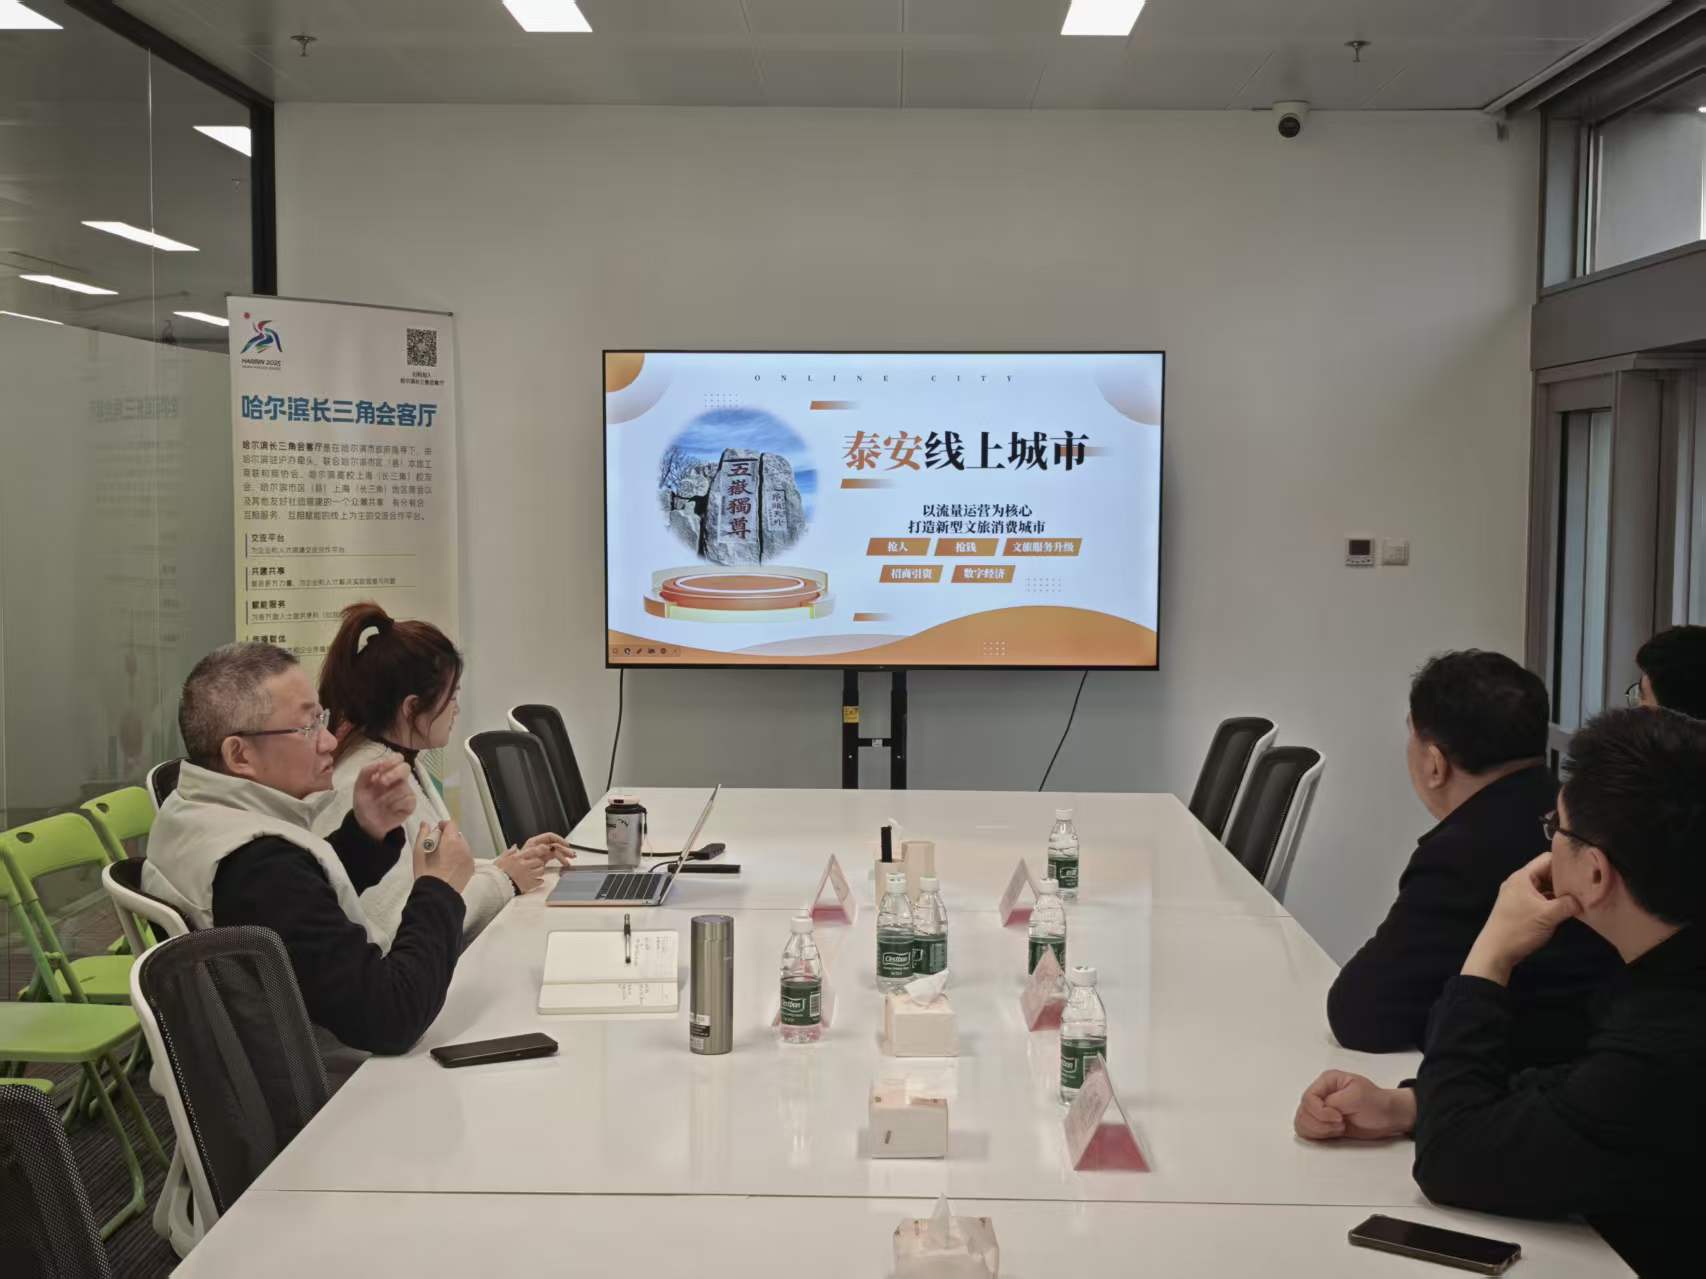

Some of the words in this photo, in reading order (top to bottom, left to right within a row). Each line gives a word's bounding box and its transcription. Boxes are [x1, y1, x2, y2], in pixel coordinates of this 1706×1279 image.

[754, 374, 890, 382] ONLINE
[931, 374, 1015, 383] CITY
[241, 394, 438, 427] 哈尔滨长三角会客厅
[842, 429, 1090, 471] 泰安线上城市
[922, 503, 1033, 518] 以流量运营为核心
[908, 519, 1045, 534] 打造新型文旅消费城市
[251, 533, 285, 543] 交流平台
[887, 541, 908, 553] 抢人
[955, 541, 977, 553] 抢钱
[1012, 541, 1074, 553] 文旅服务升级
[251, 566, 285, 576] 共建共享
[891, 568, 933, 580] 招商引资
[963, 567, 1006, 580] 数字经济
